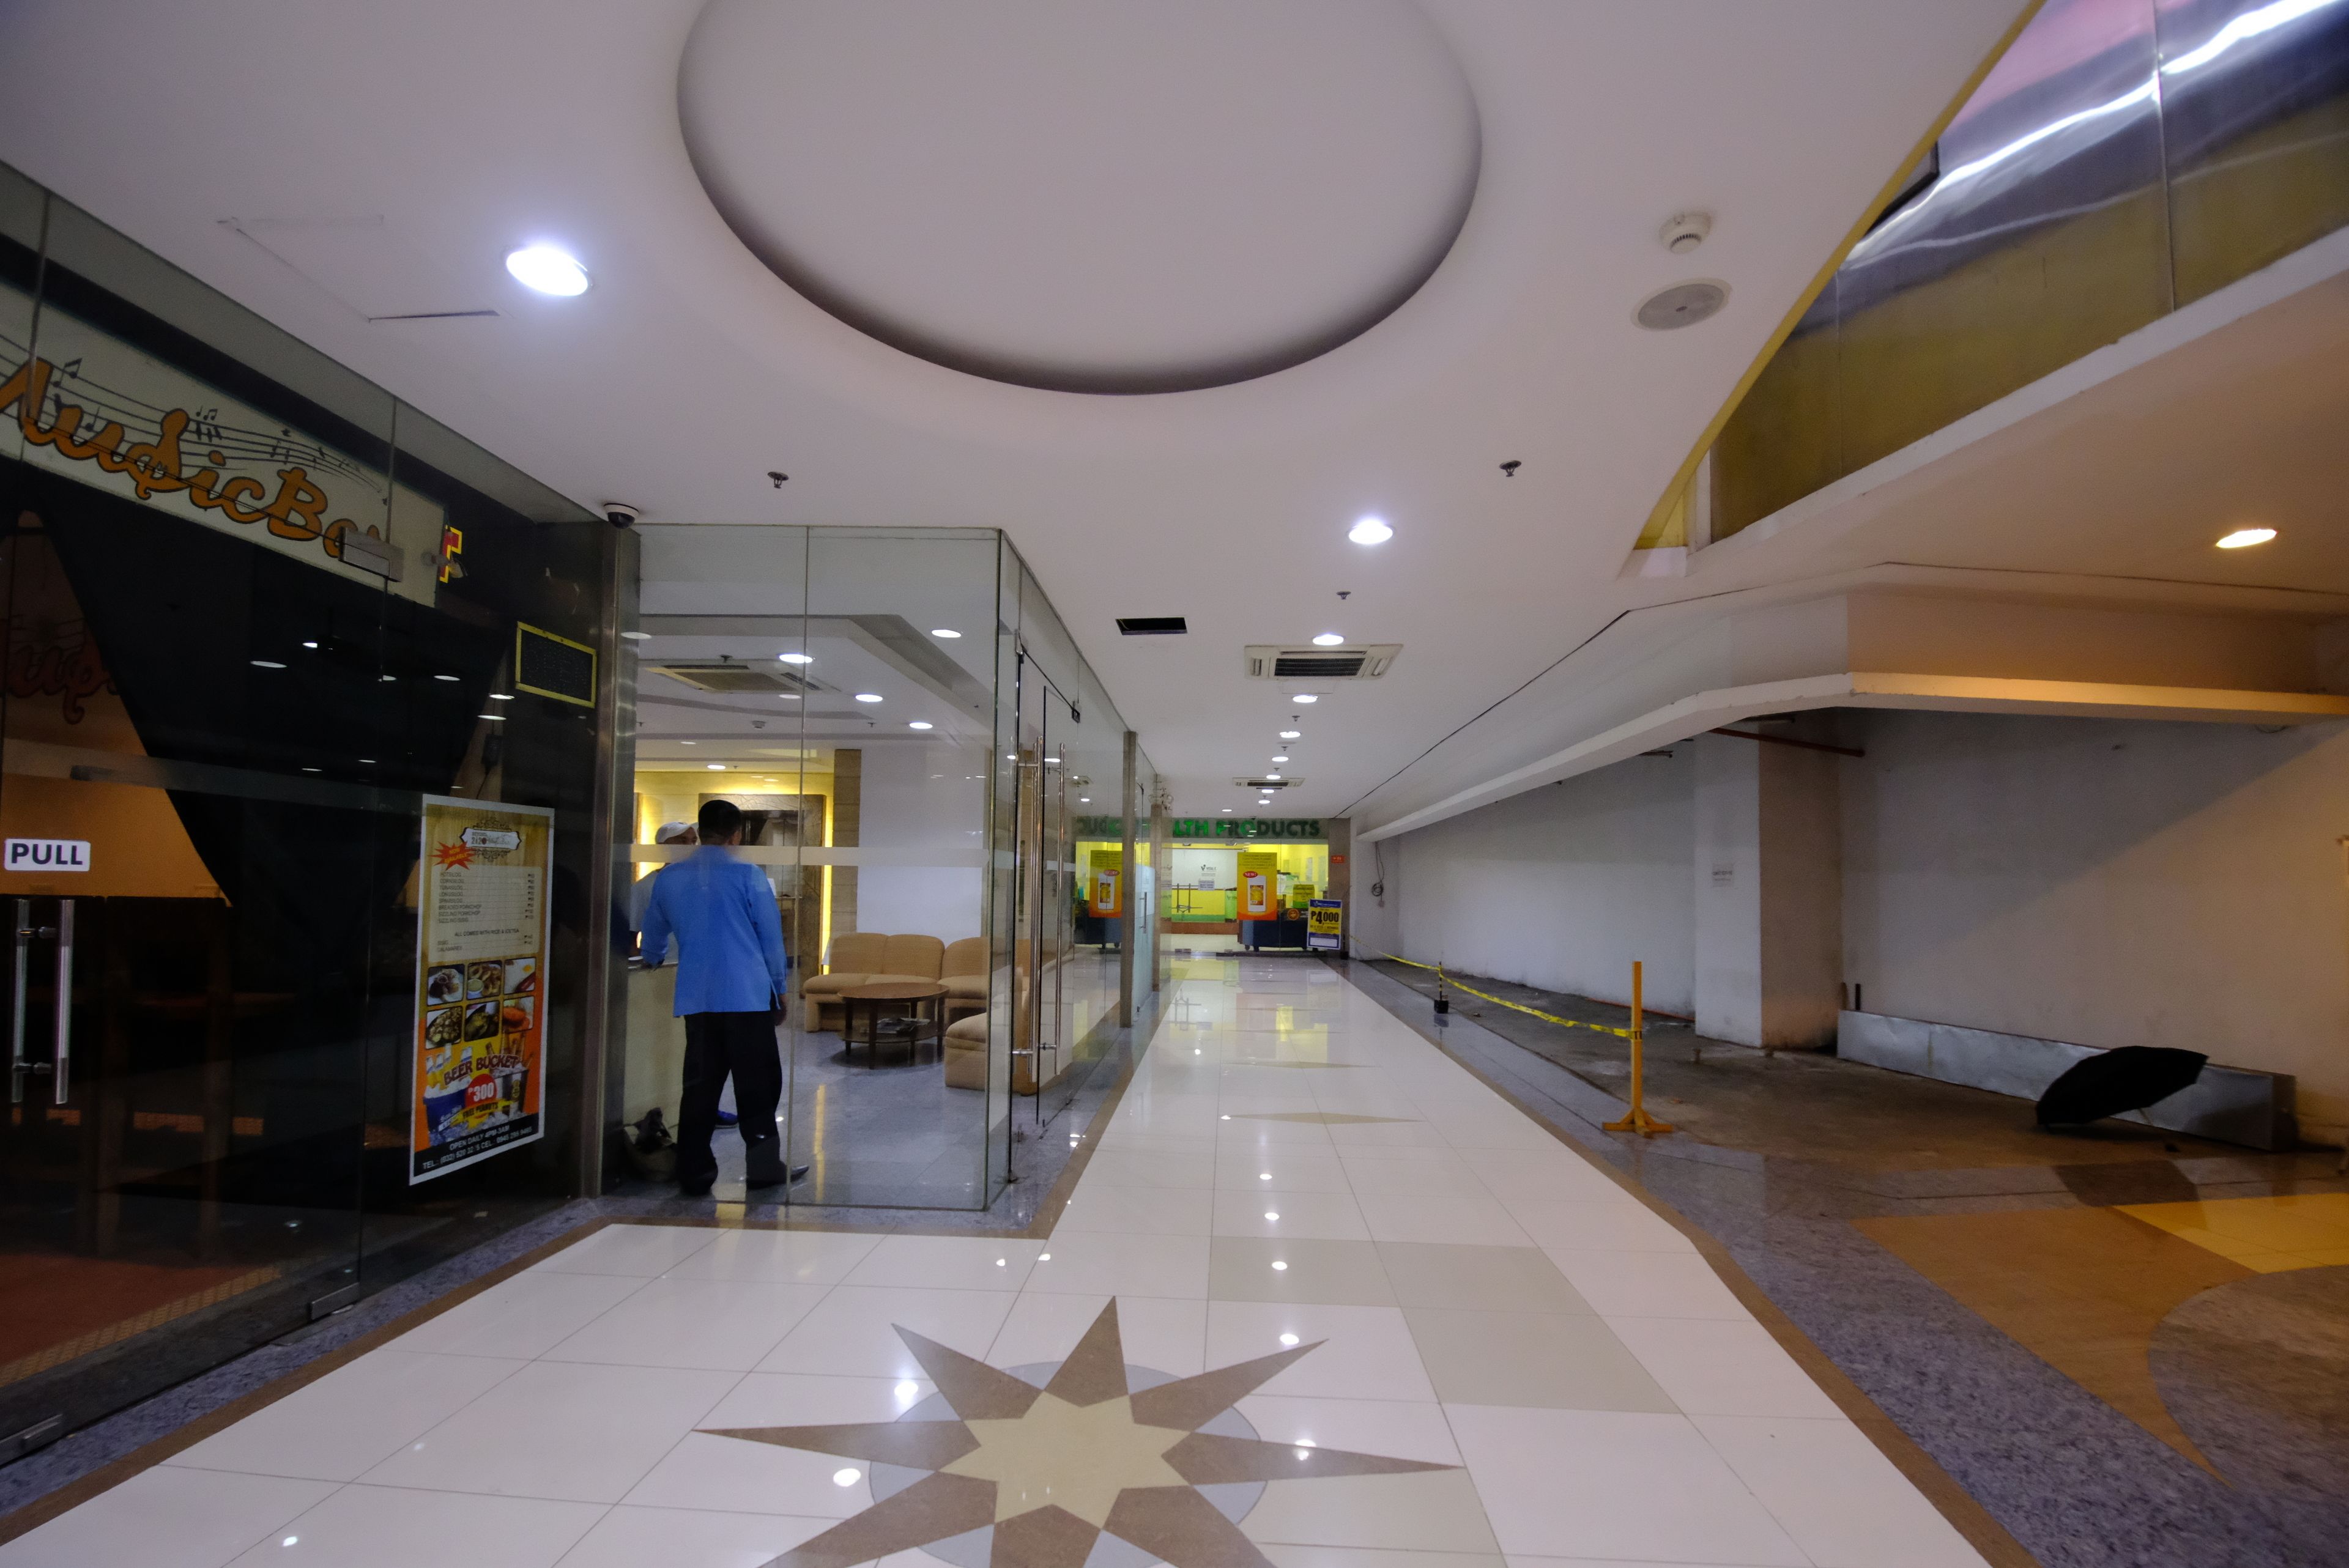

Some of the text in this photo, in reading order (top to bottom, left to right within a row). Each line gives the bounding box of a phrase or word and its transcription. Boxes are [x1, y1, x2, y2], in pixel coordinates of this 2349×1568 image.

[1215, 820, 1320, 837] PRODUCTS
[11, 843, 83, 865] PULL
[444, 1055, 517, 1085] BEER BUCKET
[463, 1108, 475, 1119] FREE
[476, 1103, 499, 1113] PEANUTS
[449, 1140, 468, 1151] OPEN
[467, 1133, 484, 1145] DAILY
